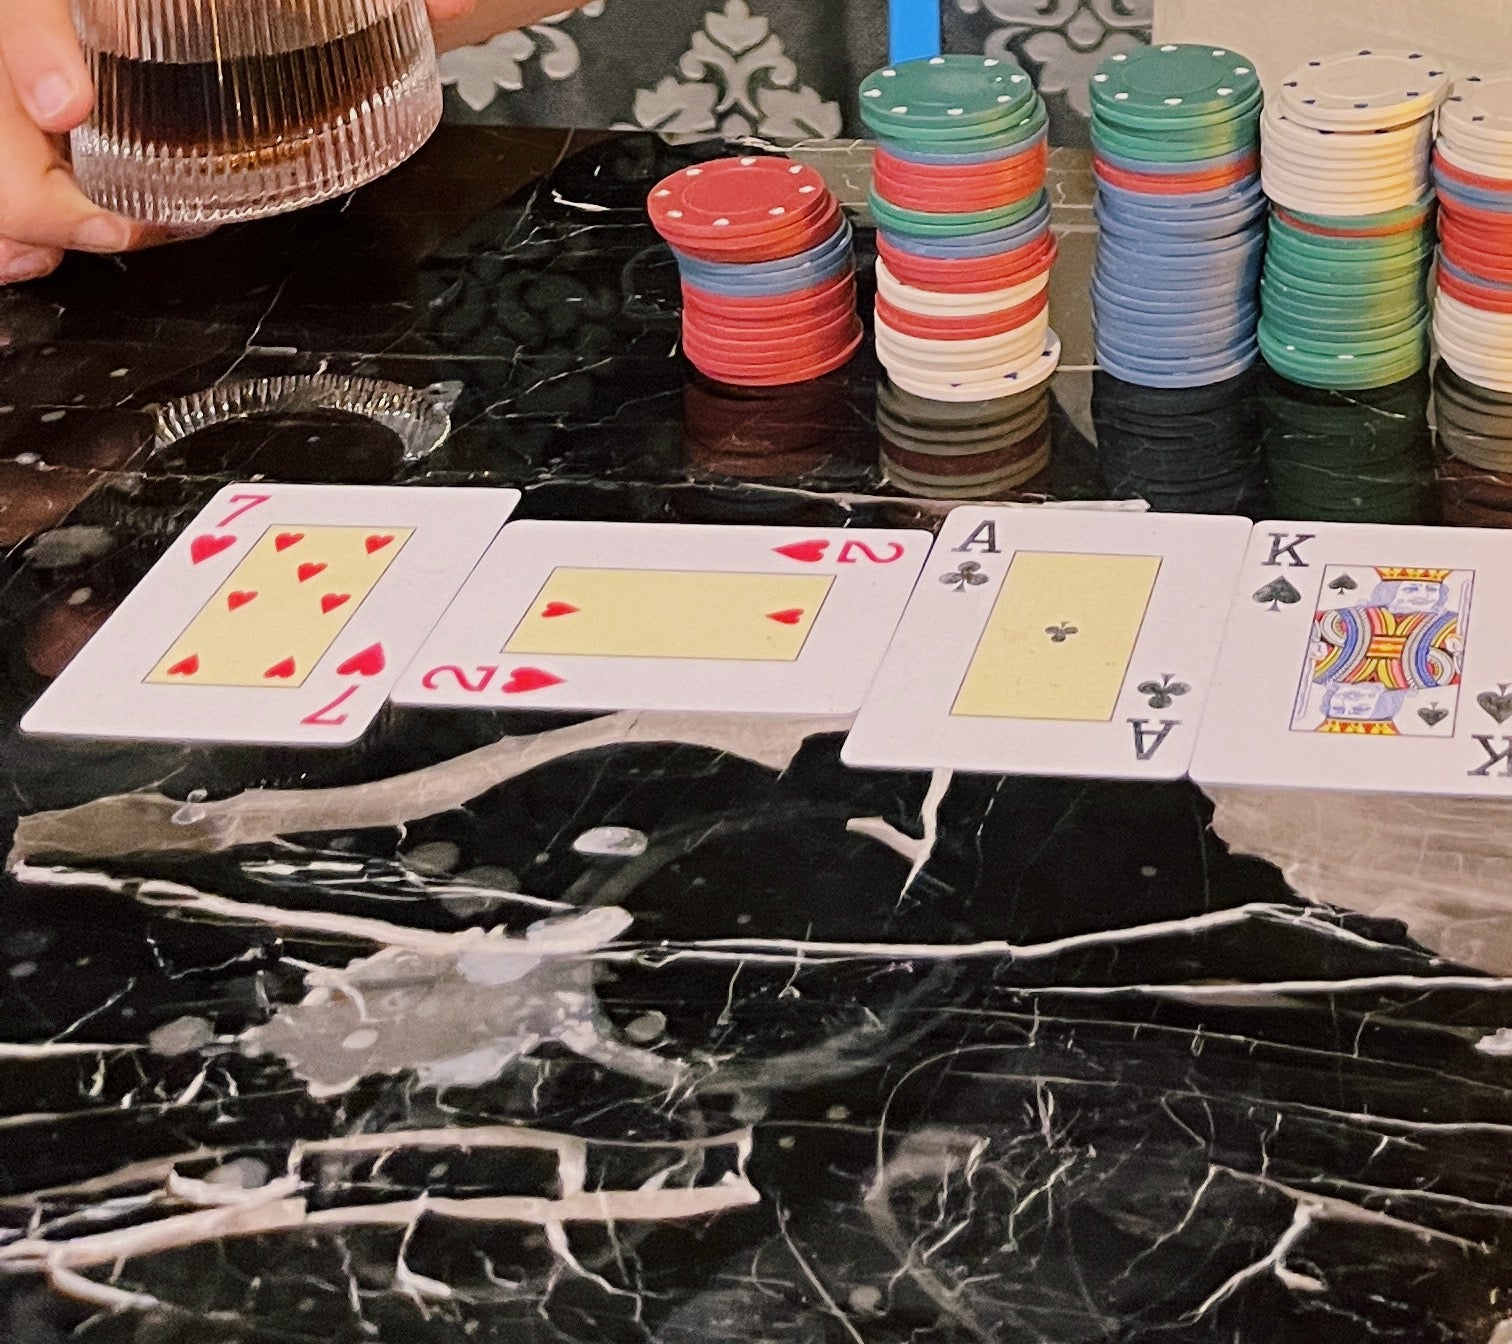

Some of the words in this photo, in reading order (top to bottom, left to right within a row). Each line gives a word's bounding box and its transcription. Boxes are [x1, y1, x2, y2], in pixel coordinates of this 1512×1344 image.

[216, 494, 272, 529] 7
[835, 539, 906, 565] 2
[951, 519, 1002, 554] A
[1261, 532, 1317, 568] K
[420, 664, 499, 694] 2
[300, 683, 362, 726] 7
[1126, 718, 1183, 762] A
